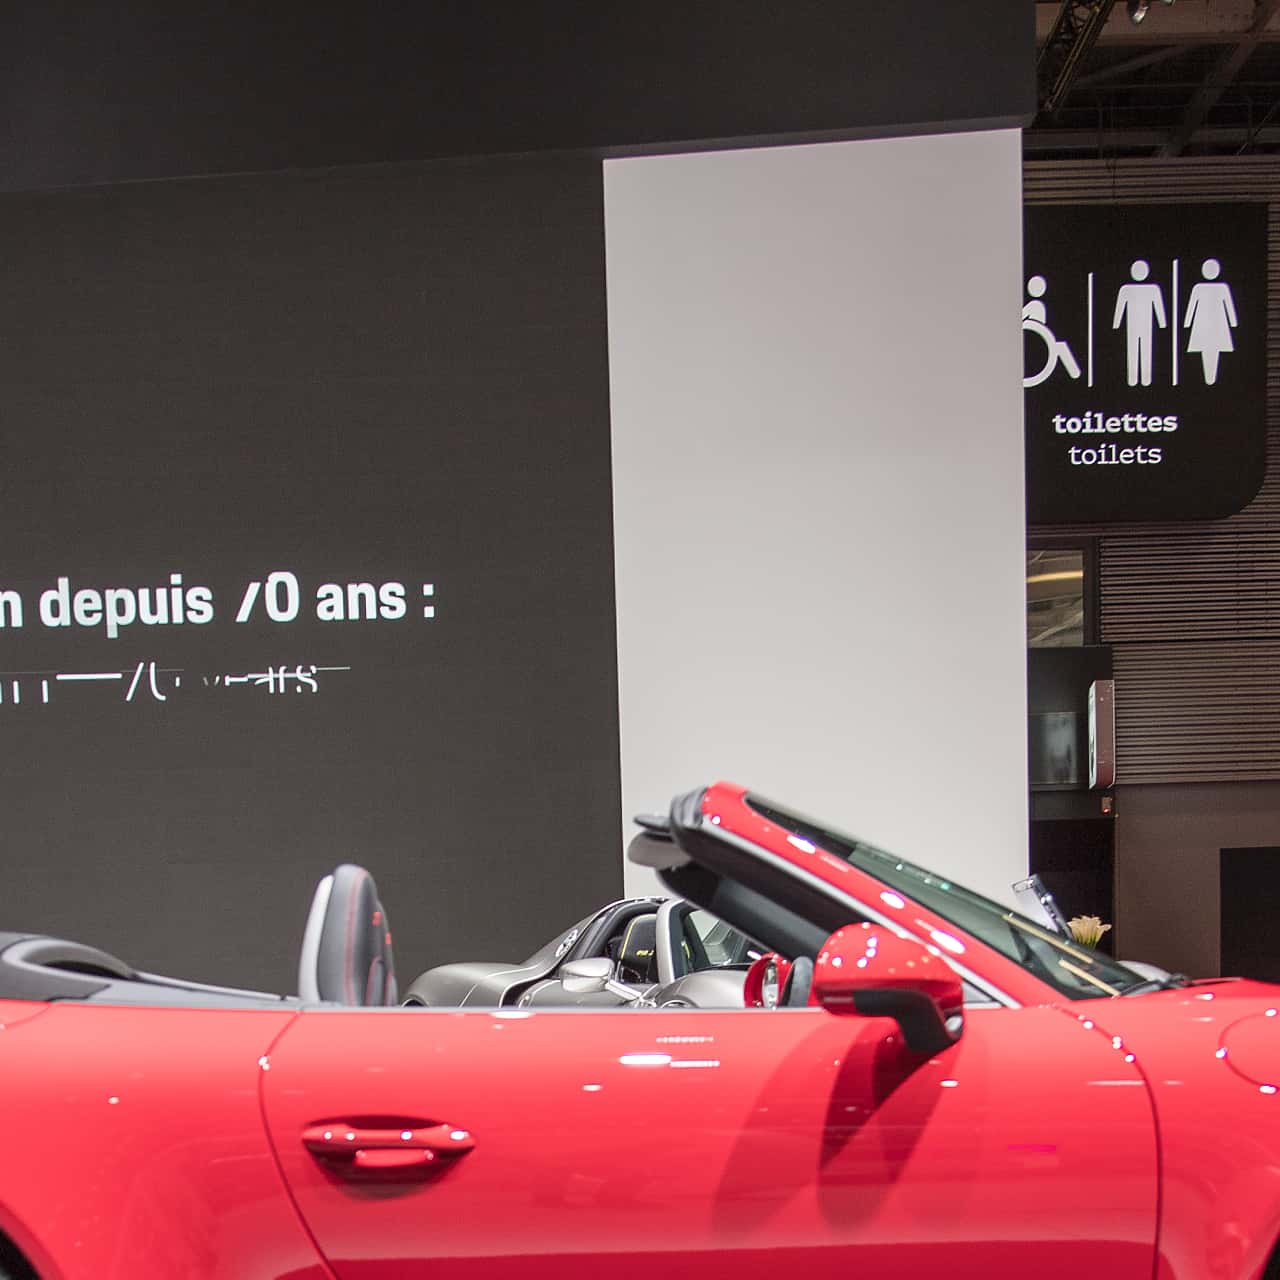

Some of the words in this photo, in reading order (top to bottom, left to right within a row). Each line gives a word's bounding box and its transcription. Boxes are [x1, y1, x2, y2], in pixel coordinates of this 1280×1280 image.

[1051, 410, 1179, 434] toilettes
[1067, 443, 1163, 466] toilets
[39, 573, 214, 639] depuis
[316, 580, 408, 621] ans
